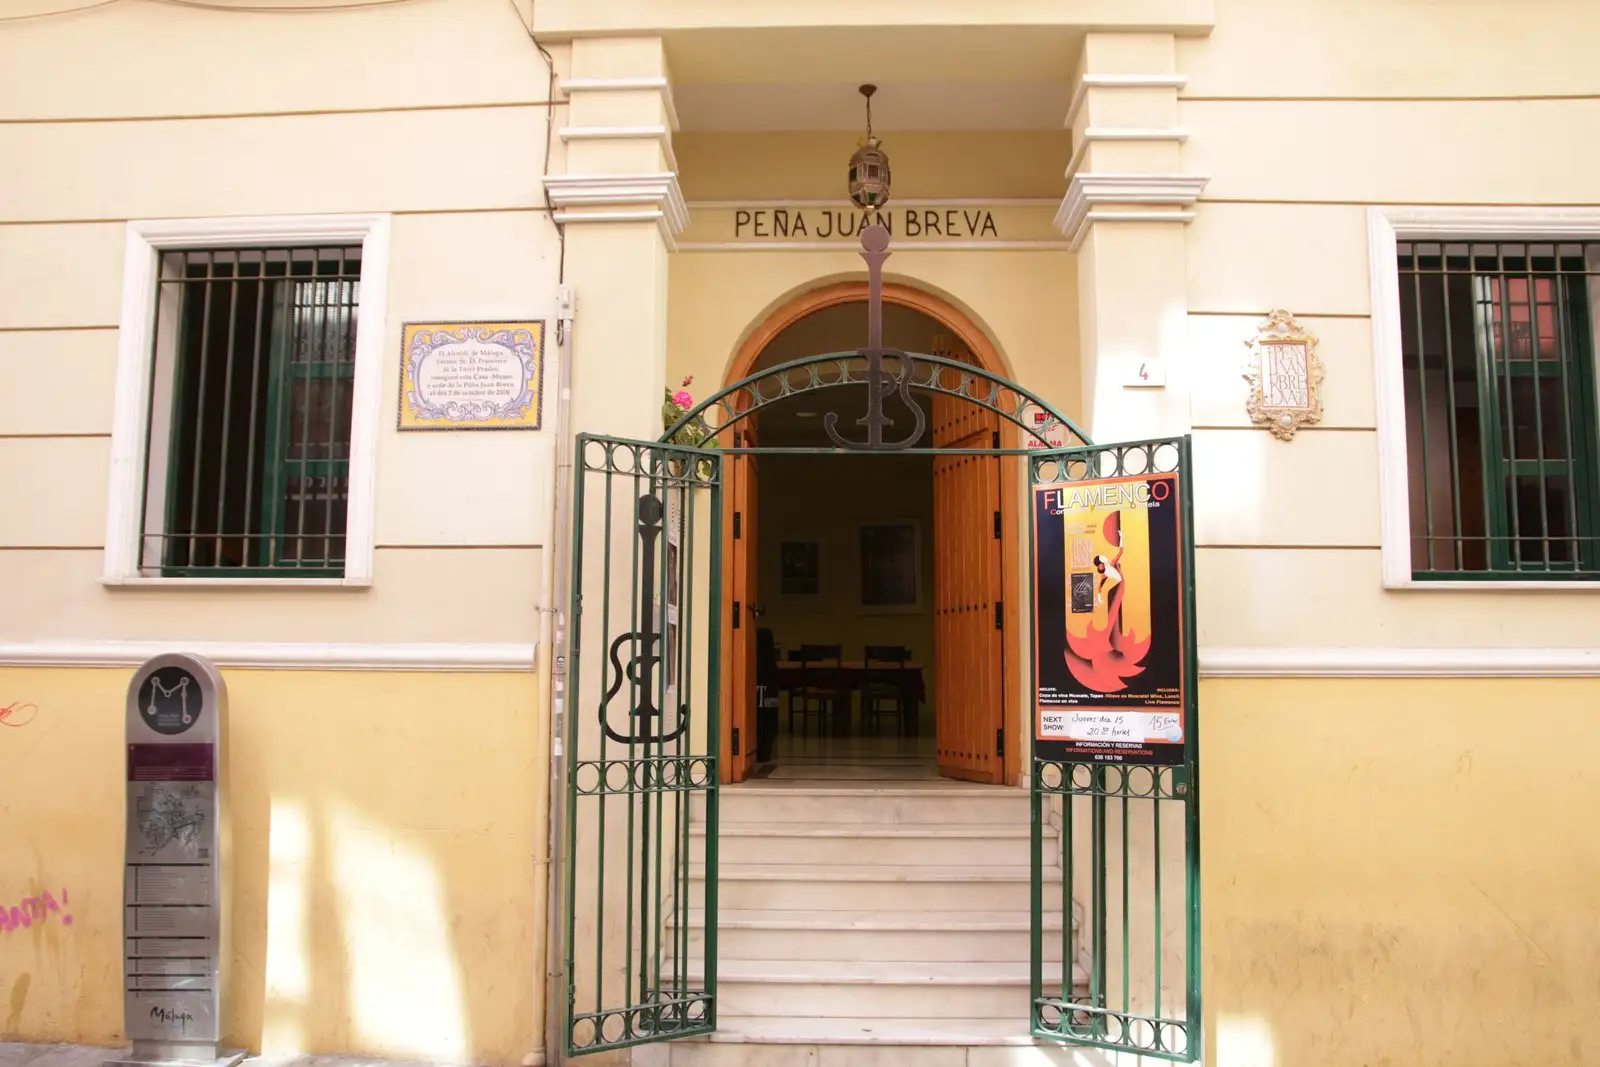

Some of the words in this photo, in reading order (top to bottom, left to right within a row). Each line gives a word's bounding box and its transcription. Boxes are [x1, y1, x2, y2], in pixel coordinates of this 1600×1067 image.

[735, 209, 808, 238] PEÑA
[816, 210, 893, 238] JUAN
[905, 209, 999, 238] BREVA
[1139, 363, 1149, 380] 4
[1043, 481, 1170, 510] FLAMENCO
[1114, 715, 1124, 724] 15
